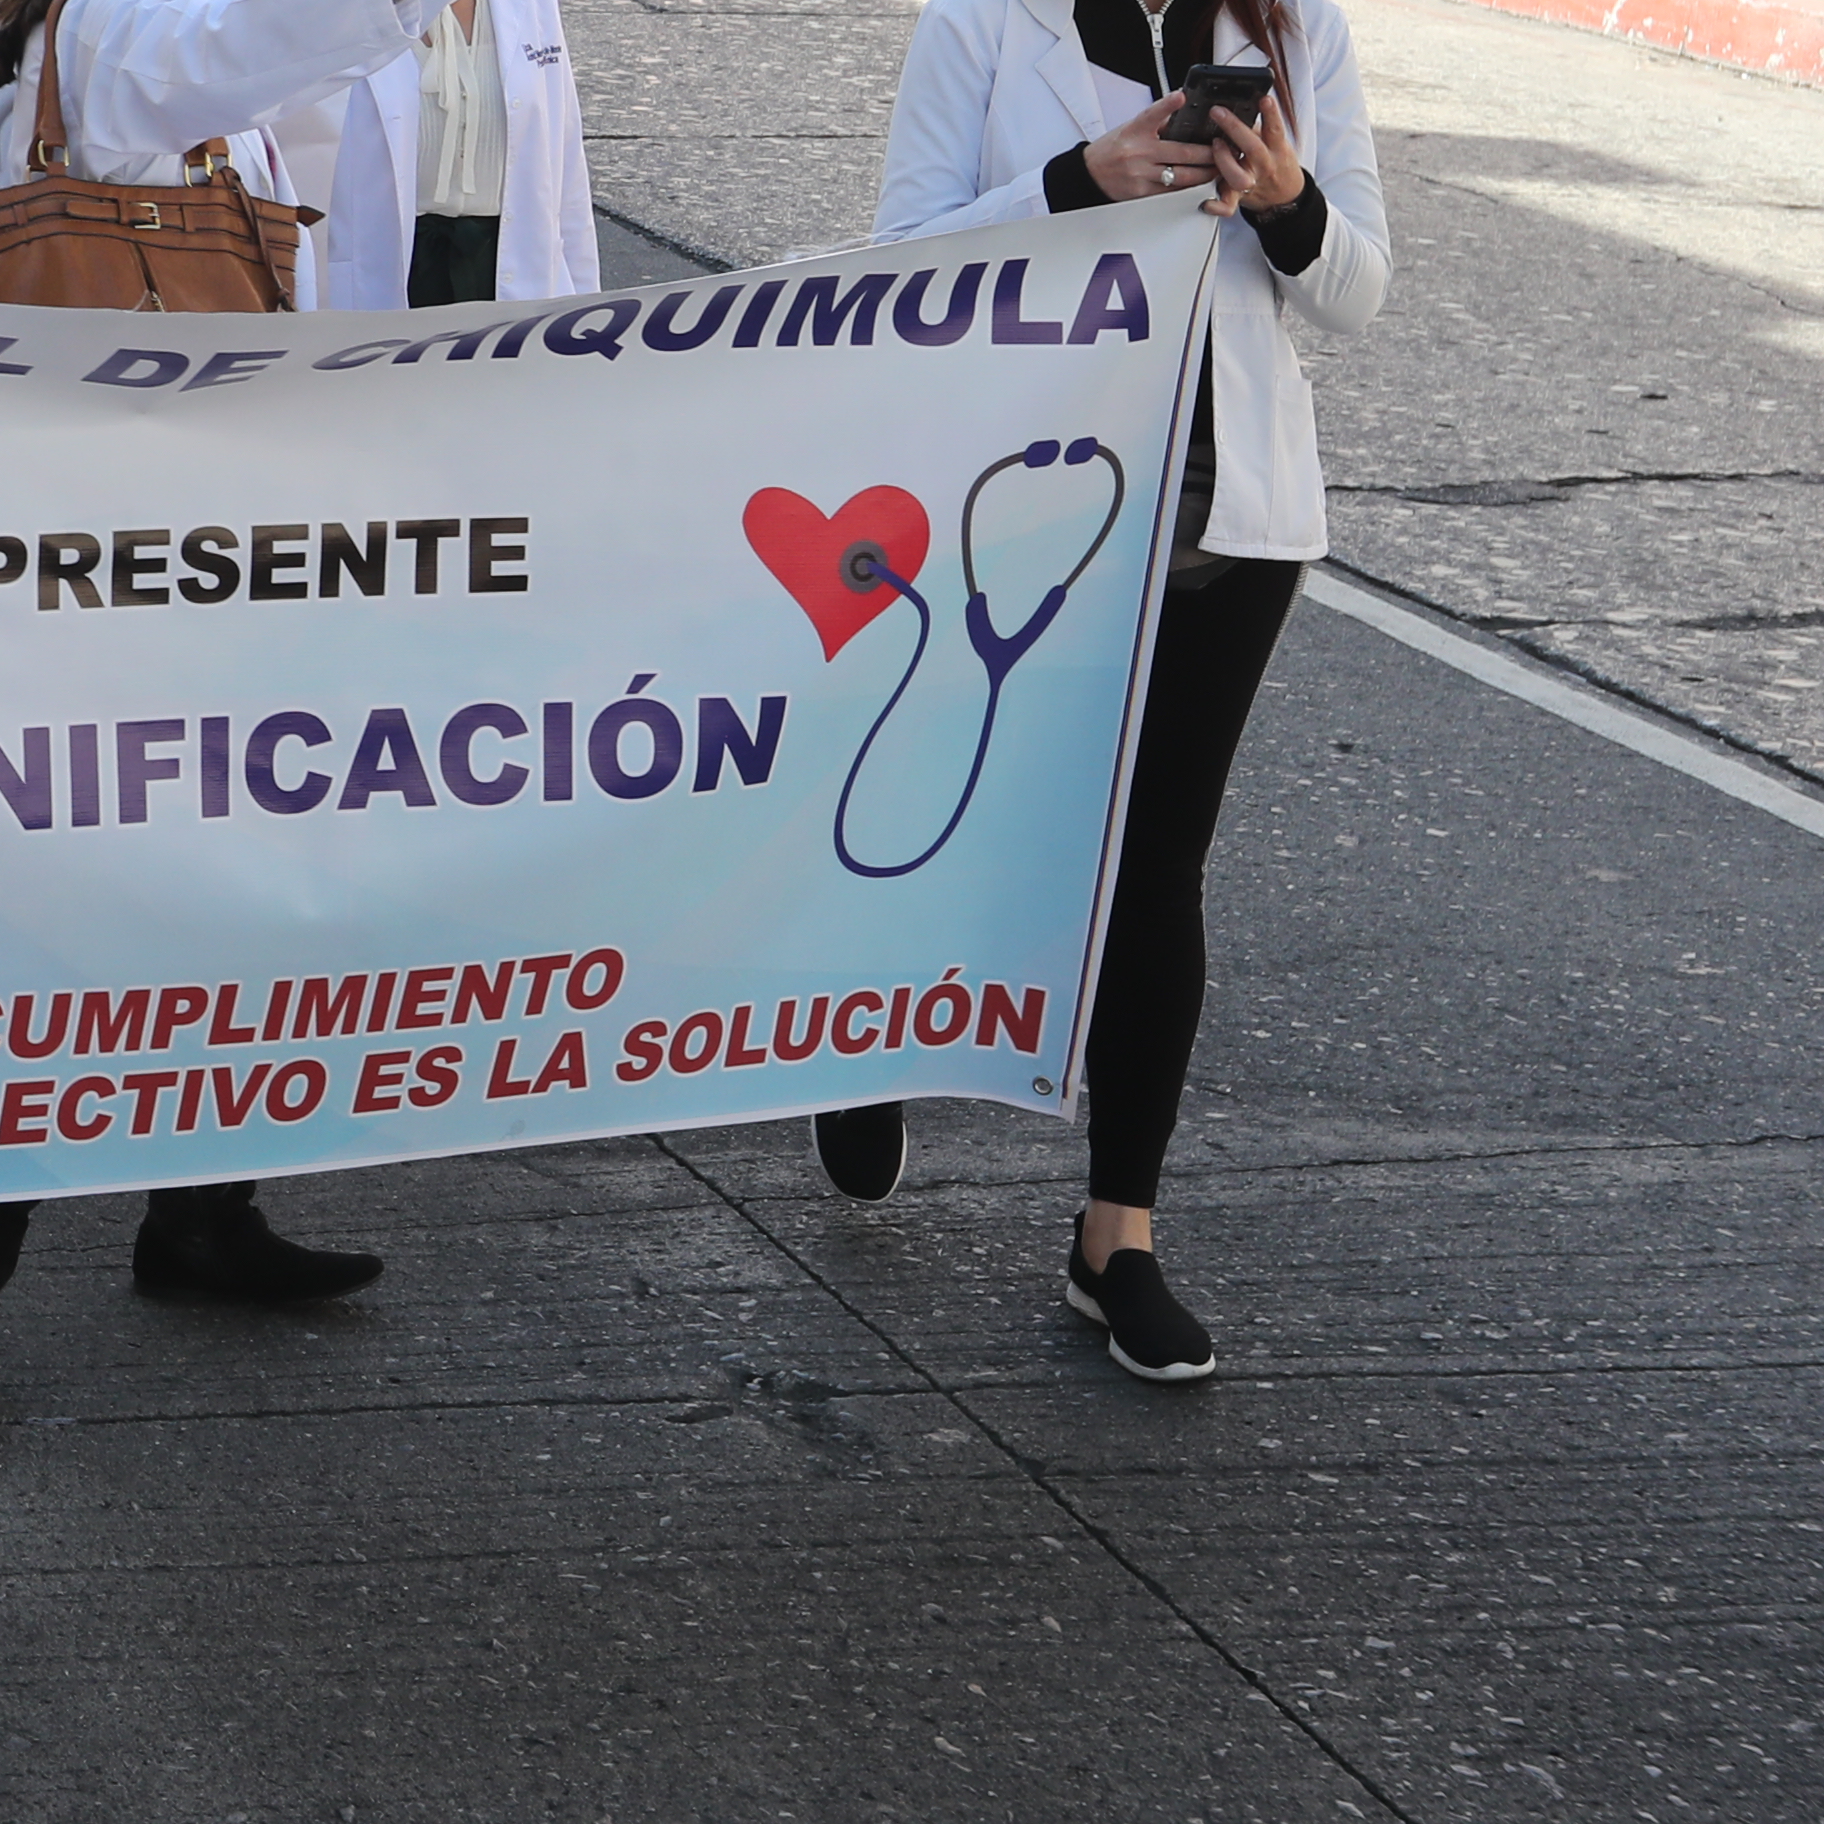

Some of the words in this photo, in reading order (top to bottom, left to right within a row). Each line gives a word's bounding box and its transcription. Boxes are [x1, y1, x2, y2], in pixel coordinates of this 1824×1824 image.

[82, 347, 290, 393] DE
[312, 252, 1151, 371] CHIQUIMULA
[354, 1046, 463, 1114] ES
[488, 1032, 587, 1099] LA
[617, 967, 1046, 1082] SOLUCIÓN
